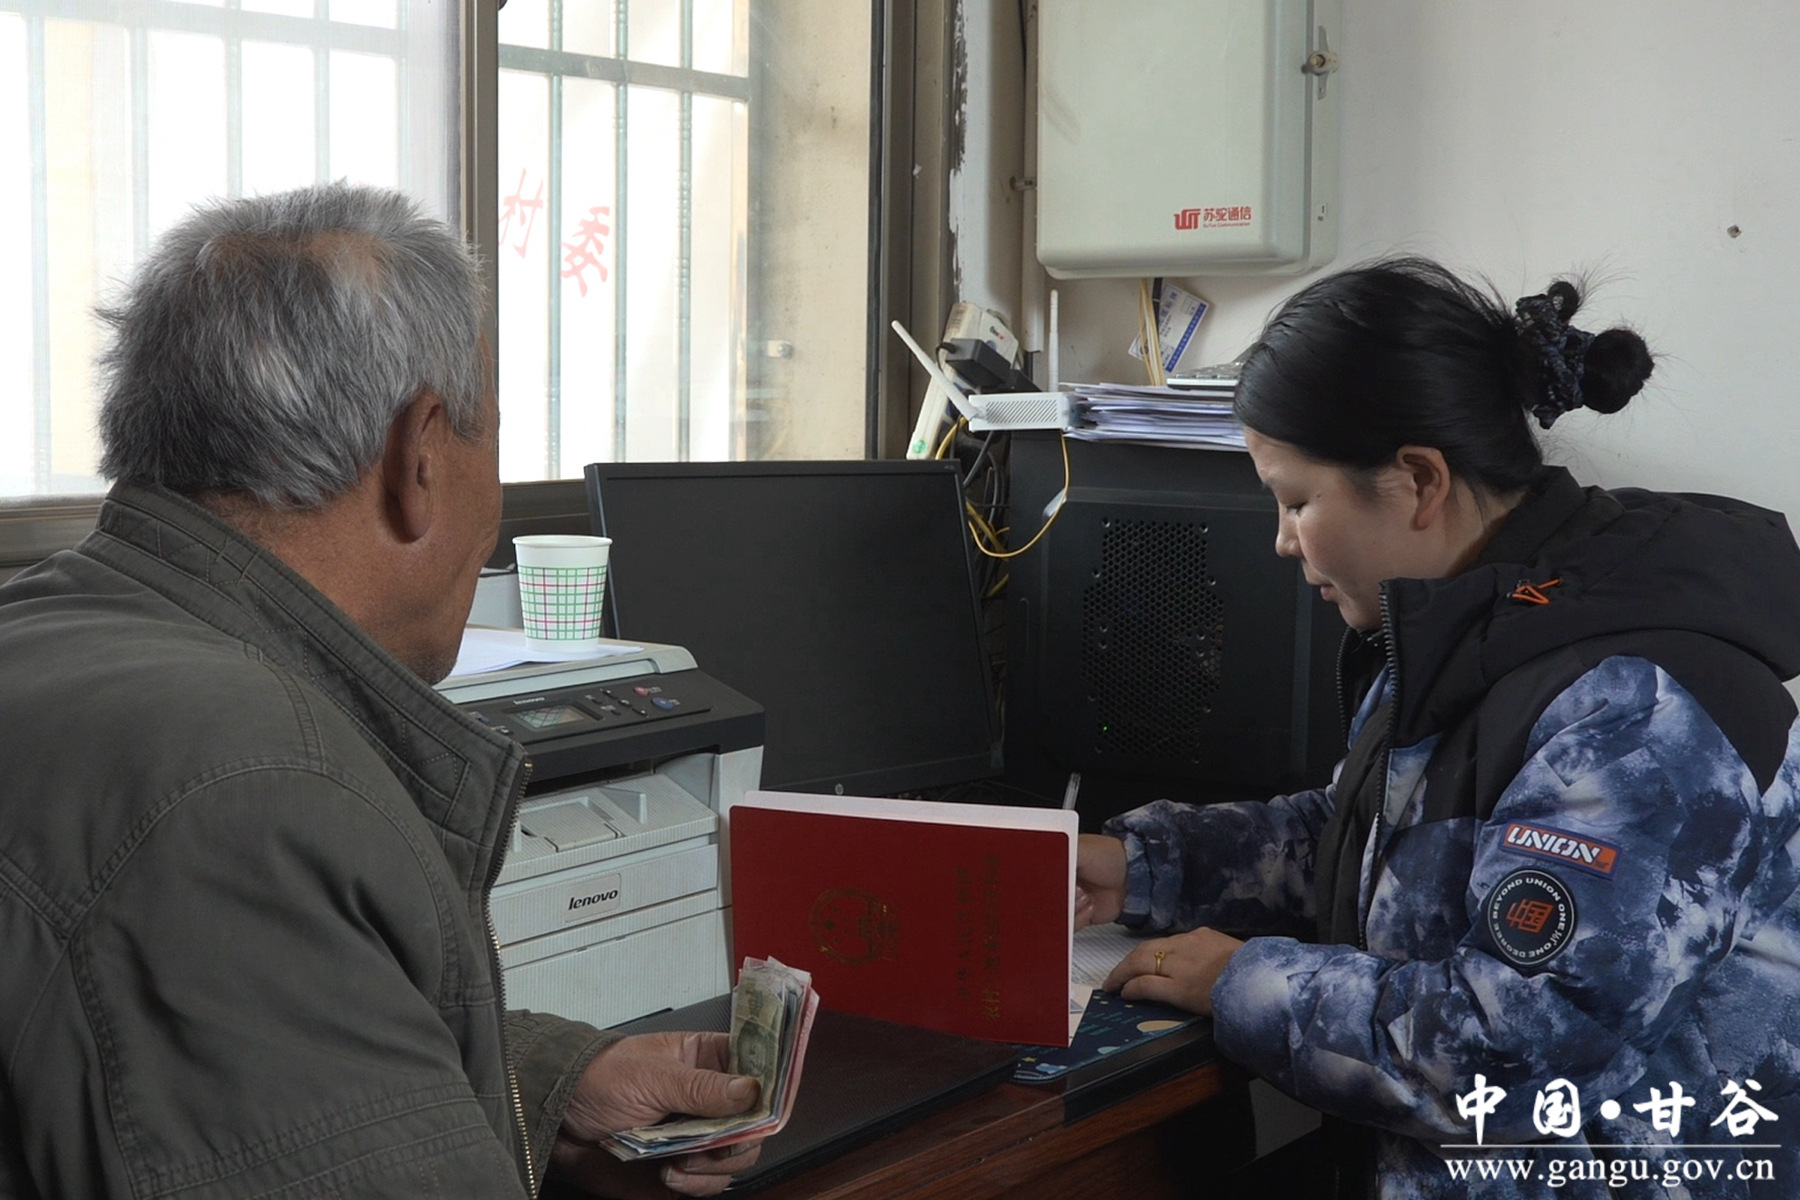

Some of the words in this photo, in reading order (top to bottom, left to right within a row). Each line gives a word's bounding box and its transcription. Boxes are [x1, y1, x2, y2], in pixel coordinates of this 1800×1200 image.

[1507, 827, 1600, 864] UNION
[568, 889, 619, 911] lenovo
[1492, 878, 1523, 919] BEYOND
[1525, 877, 1562, 902] UNION
[1557, 903, 1567, 931] ONE
[1493, 922, 1526, 958] DEGREE
[1528, 942, 1552, 958] ONE
